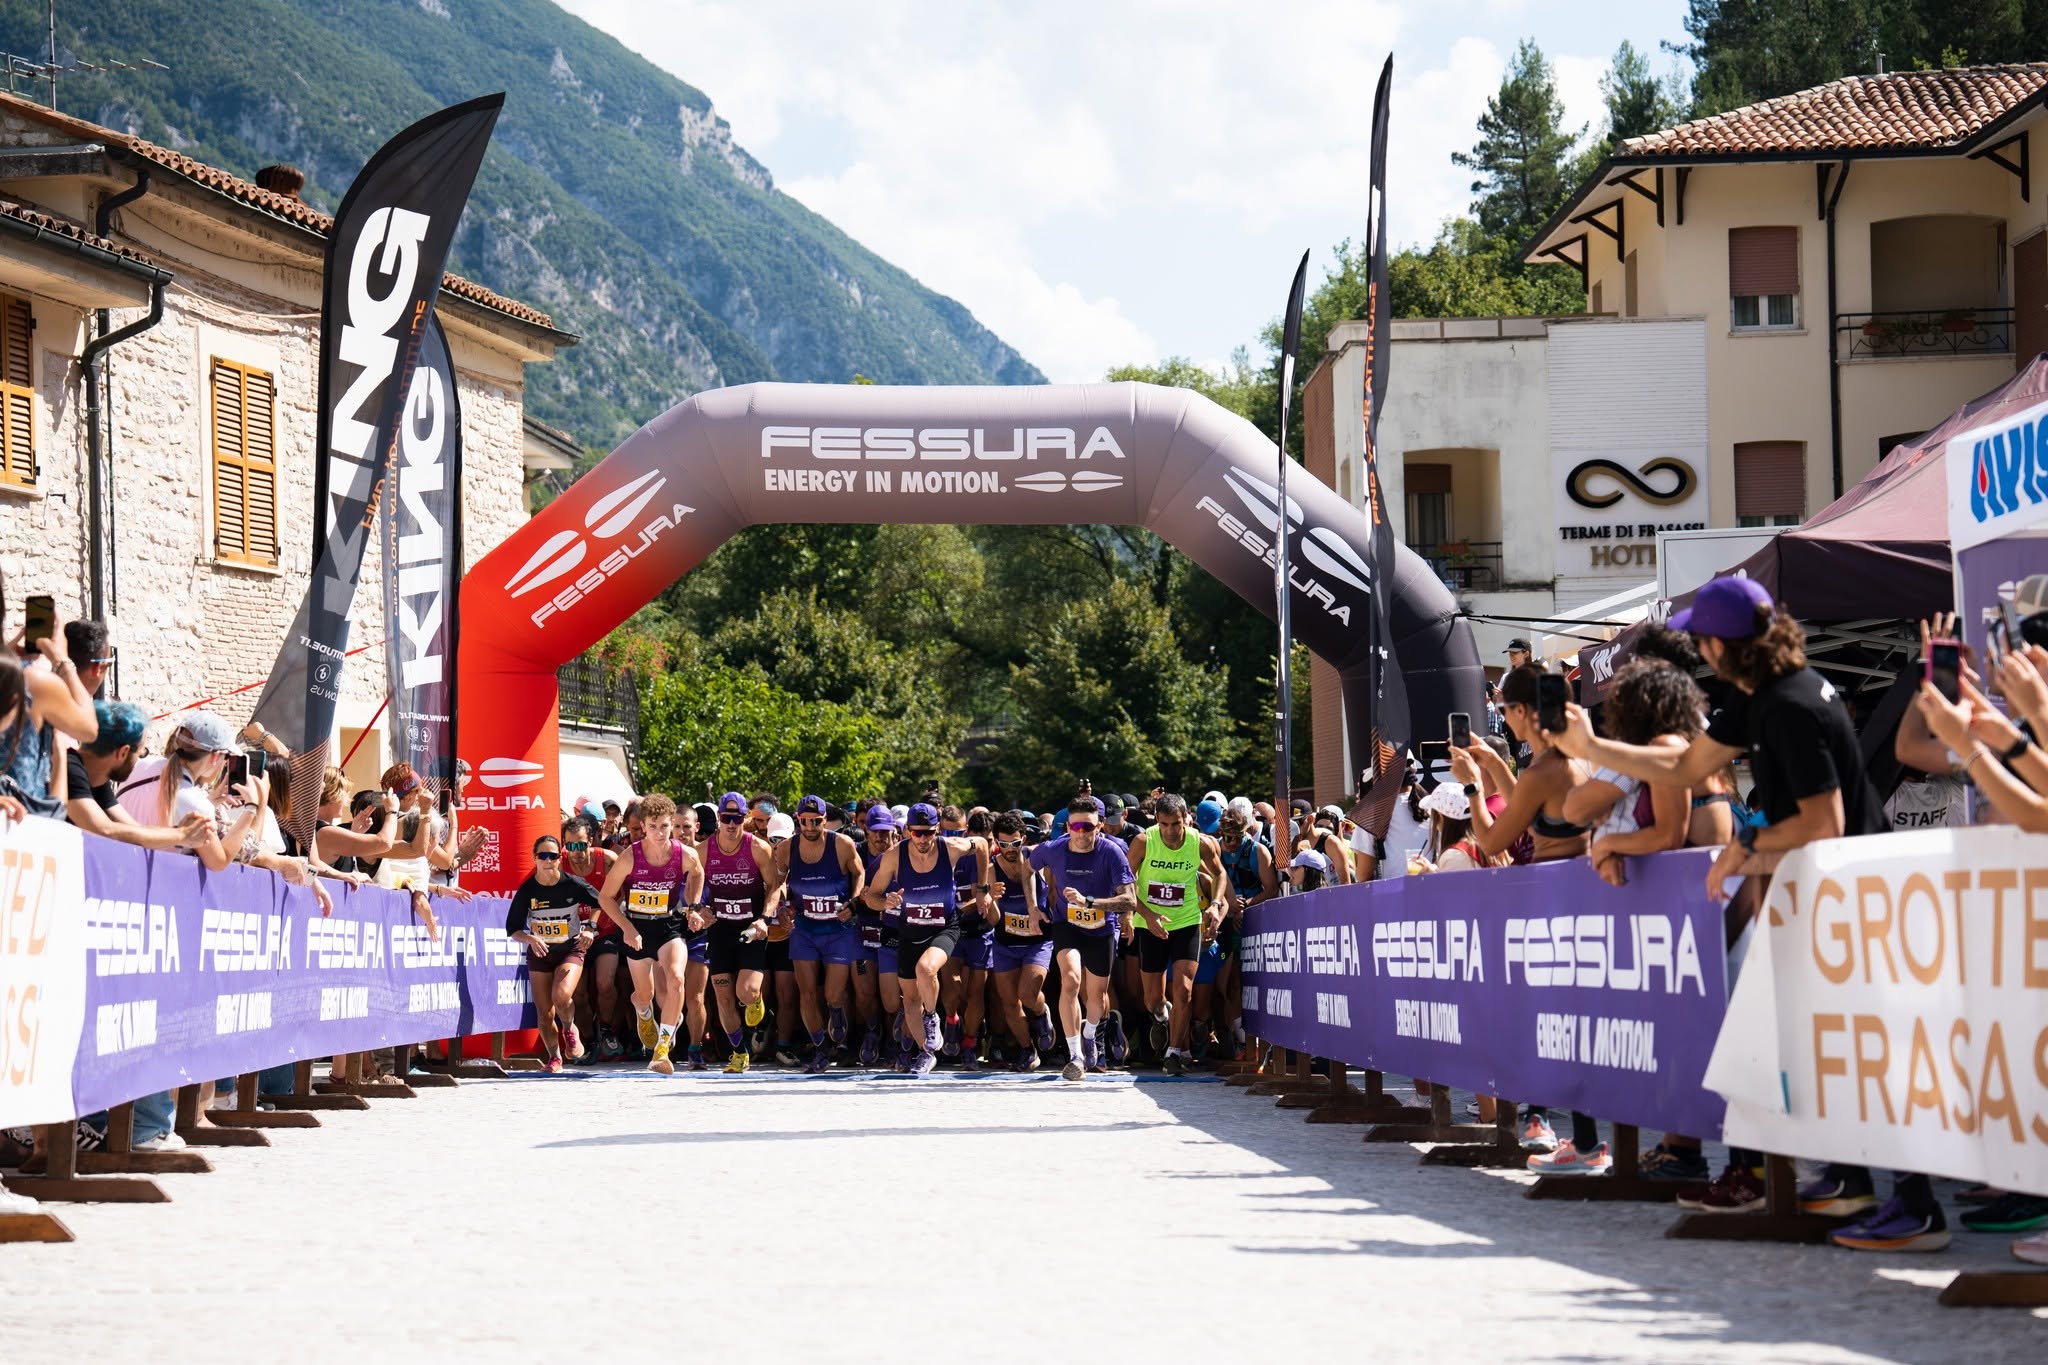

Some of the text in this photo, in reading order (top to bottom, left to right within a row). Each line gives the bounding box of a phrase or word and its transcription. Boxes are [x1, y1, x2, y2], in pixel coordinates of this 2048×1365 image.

[761, 426, 1126, 460] FESSURA
[764, 469, 1008, 494] ENERGY IN MOTION.
[1369, 471, 1381, 525] FIND
[1559, 525, 1611, 540] TERME
[1615, 525, 1633, 538] DI
[530, 503, 697, 629] FESSURA
[1895, 807, 1947, 827] STAFF
[1150, 859, 1185, 870] CRAFT
[638, 894, 659, 906] 311
[1160, 887, 1173, 899] 15
[725, 903, 741, 914] 88
[810, 901, 830, 912] 101
[917, 908, 932, 918] 72
[1075, 910, 1097, 922] 351
[199, 908, 291, 972] FESSURA
[537, 924, 560, 935] 395
[306, 917, 385, 969] FESSURA
[391, 925, 477, 969] FESSURA
[1306, 924, 1361, 976] FESSURA
[1373, 918, 1485, 982] FESSURA
[1505, 913, 1706, 997] FESSURA
[1537, 1012, 1577, 1061] ENERGY
[1593, 1017, 1658, 1073] MOTION.
